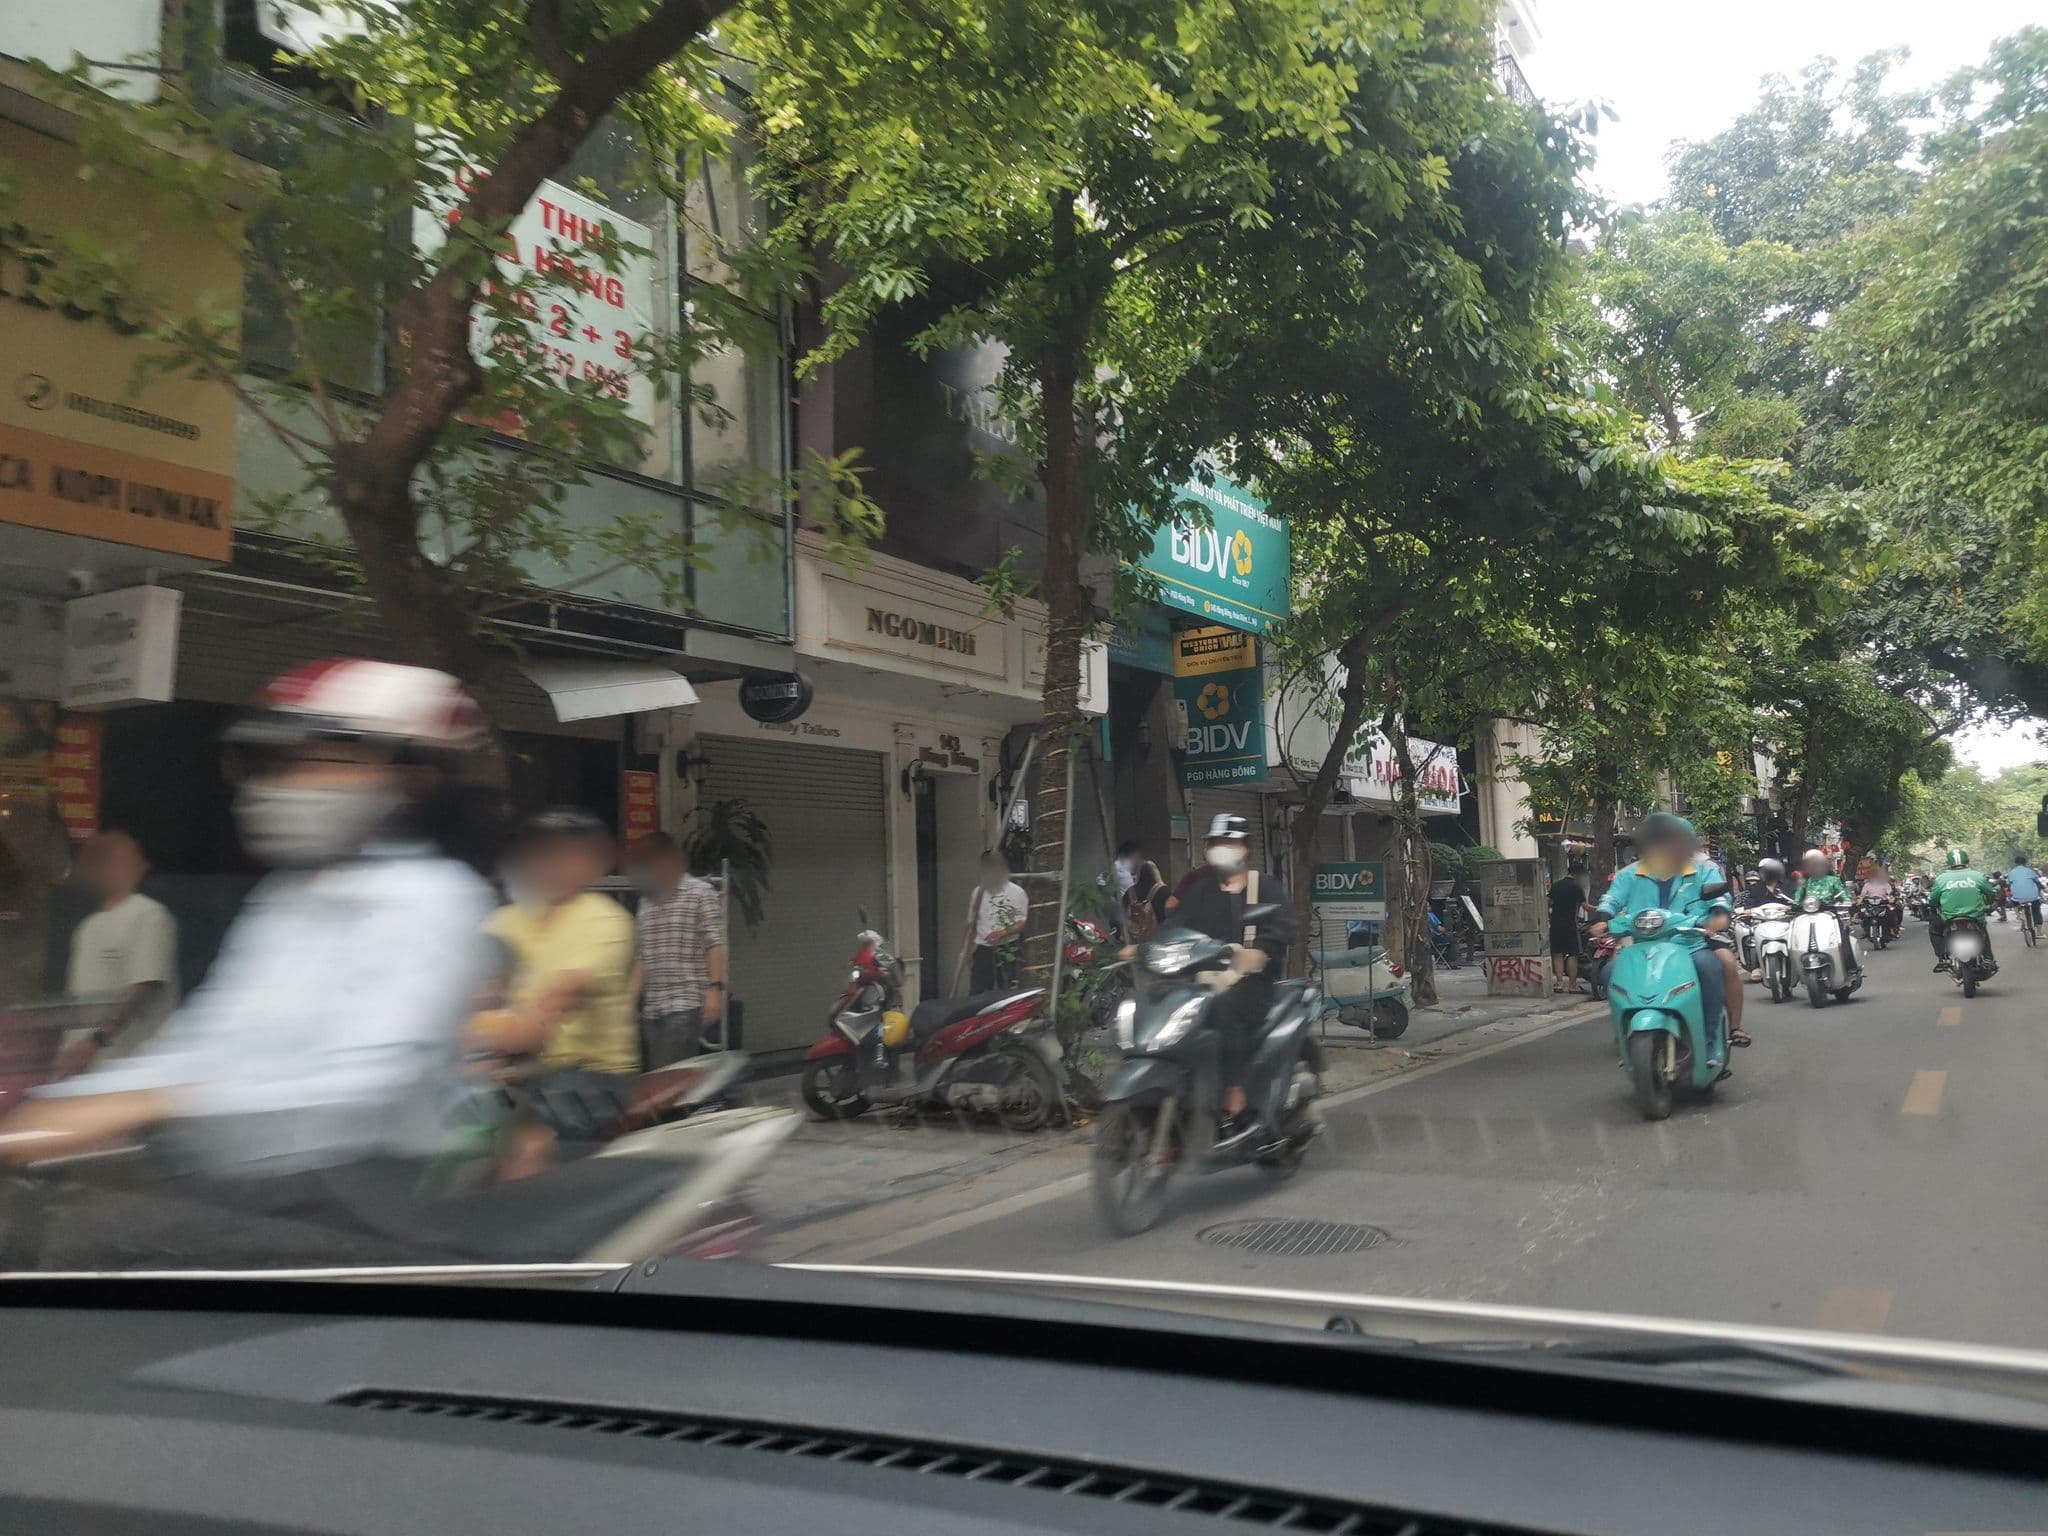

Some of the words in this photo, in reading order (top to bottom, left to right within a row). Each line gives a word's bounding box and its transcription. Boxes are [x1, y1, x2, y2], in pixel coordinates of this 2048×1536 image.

[551, 304, 569, 335] 2
[614, 330, 633, 360] 3
[1171, 518, 1234, 580] BIDV
[865, 607, 977, 656] NGOMINH
[1194, 644, 1218, 653] UNION
[1186, 721, 1252, 754] BIDV
[1187, 769, 1205, 781] PGD
[1206, 766, 1231, 780] HÀNG
[1232, 764, 1257, 776] BÔNG
[1316, 873, 1359, 890] BIDV
[1946, 878, 1976, 890] Grab
